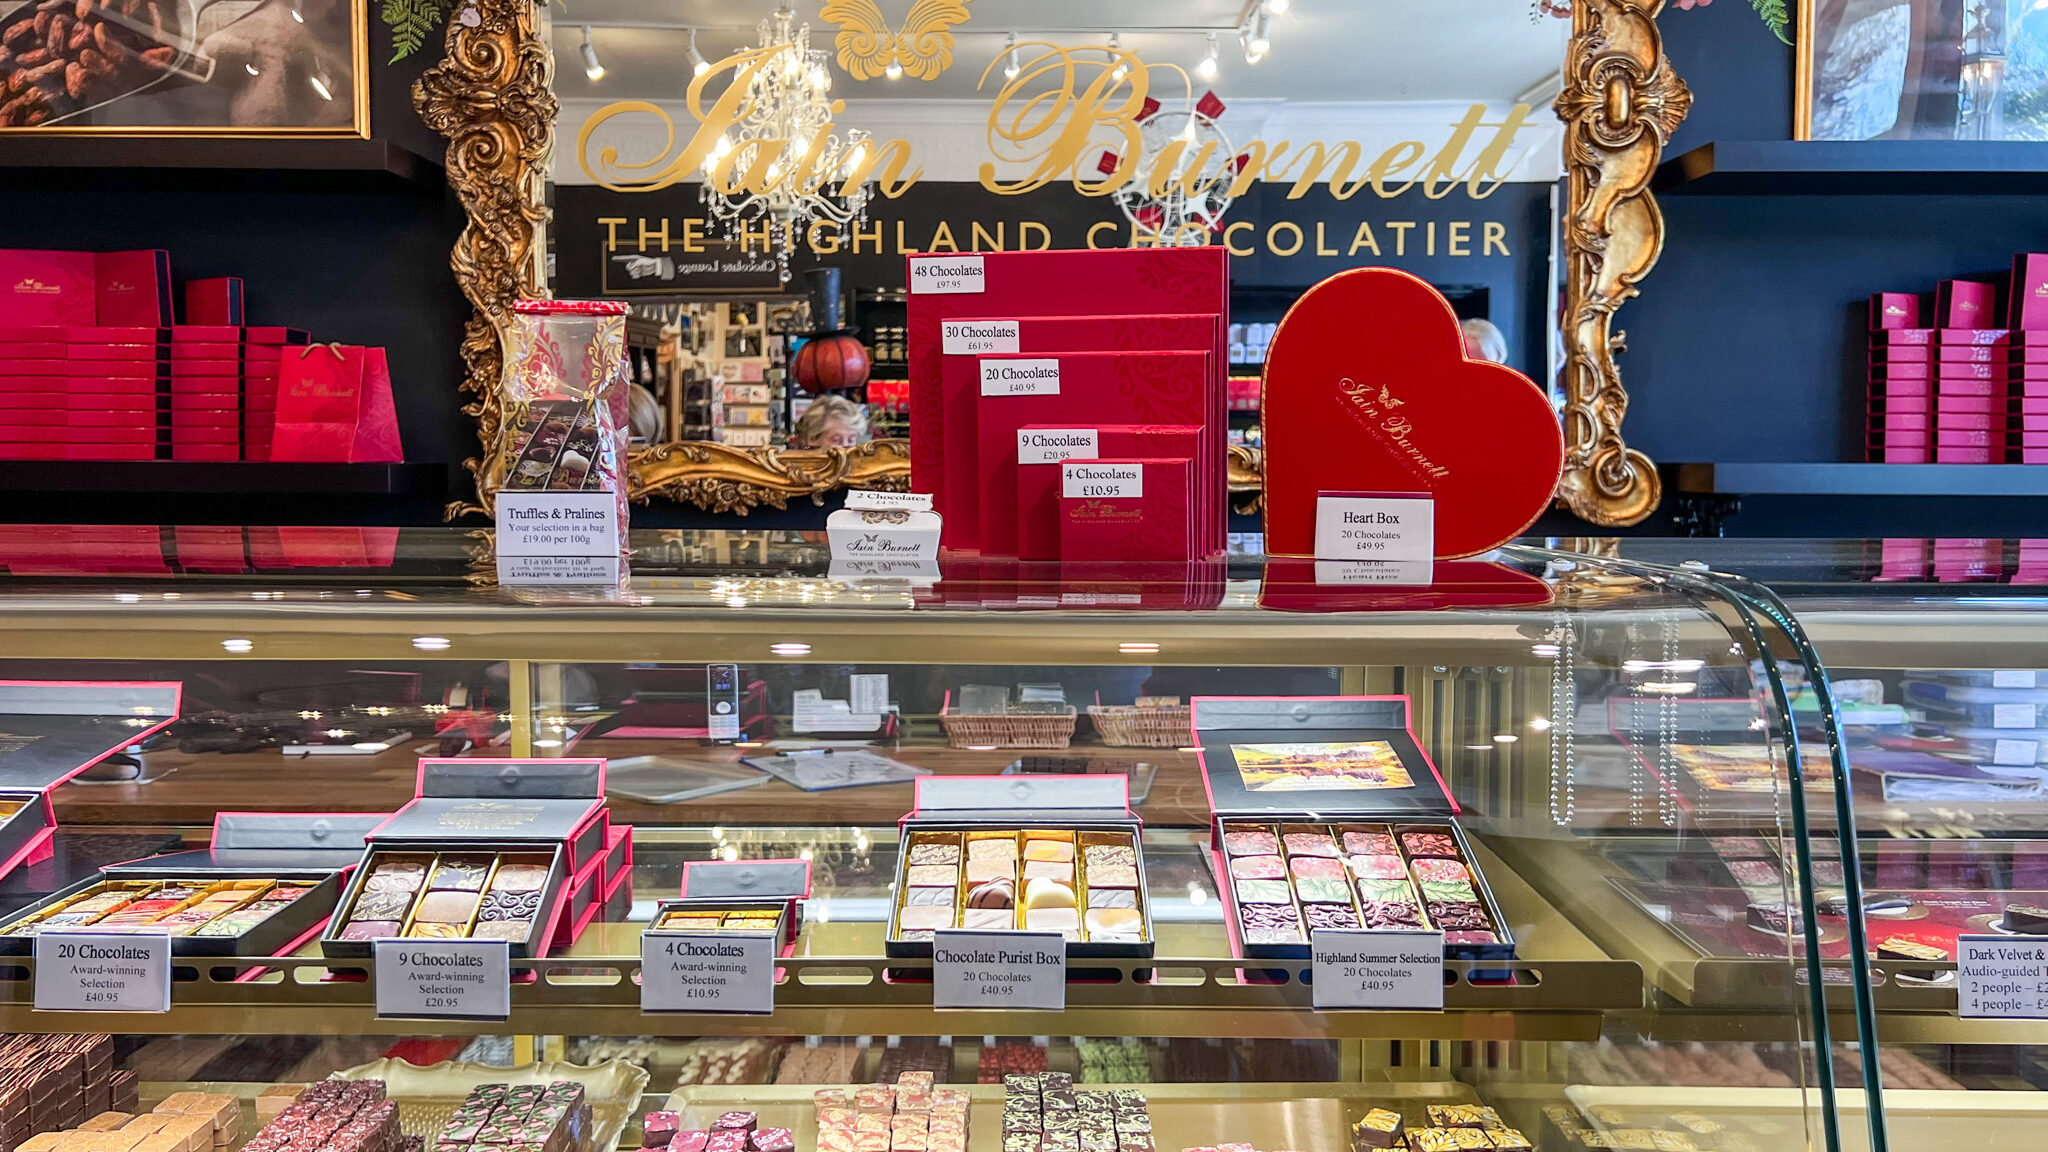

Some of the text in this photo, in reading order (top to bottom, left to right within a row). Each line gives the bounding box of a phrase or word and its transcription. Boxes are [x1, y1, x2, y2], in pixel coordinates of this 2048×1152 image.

[577, 41, 1538, 200] Iain Burnett
[597, 217, 1512, 257] THE HIGHLAND CHOCOLATIER
[914, 264, 983, 277] 48 Chocolates
[936, 280, 961, 289] £97.95
[945, 325, 1016, 338] 30 Chocolates
[968, 341, 993, 350] £61.95
[985, 366, 1059, 380] 20 Chocolates
[1009, 383, 1036, 392] £40.95
[1338, 377, 1450, 479] Iain Burnett
[1022, 434, 1091, 447] 9 Chocolates
[1043, 450, 1070, 460] £20.95
[1065, 467, 1137, 480] 4 Chocolates
[1083, 485, 1120, 496] £10.95
[867, 492, 926, 502] Chocolates
[507, 507, 605, 519] Truffles & Pralines
[1343, 511, 1400, 524] Heart Box
[508, 523, 530, 532] Your
[532, 522, 570, 532] selection
[572, 523, 580, 532] in
[589, 523, 605, 534] bag
[522, 534, 591, 545] £19.00 per 100g
[1341, 530, 1401, 540] 20 Chocolates
[846, 538, 921, 552] Iain Burnett
[1356, 541, 1385, 551] £49.95
[58, 944, 150, 960] 20 Chocolates
[665, 942, 744, 957] 4 Chocolates
[1969, 948, 2045, 961] Dark Velvet &
[399, 952, 483, 967] 9 Chocolates
[935, 949, 1061, 965] Chocolate Purist Box
[1315, 952, 1440, 965] Highland Summer Selection
[70, 964, 146, 977] Award-winning
[671, 961, 747, 975] Award-winning
[1343, 967, 1412, 977] 20 Chocolates
[1961, 966, 2040, 979] Audio-guided
[408, 971, 485, 983] Award-winning
[681, 975, 726, 985] Selection
[963, 971, 1031, 982] 20 Chocolates
[80, 978, 125, 989] Selection
[1360, 980, 1394, 990] £40.95
[1971, 981, 1978, 993] 2
[1982, 981, 2021, 995] people
[419, 985, 464, 995] Selection
[687, 988, 720, 998] £10.95
[980, 986, 1013, 995] £40.95
[85, 992, 118, 1002] £40.95
[425, 998, 458, 1008] £20.95
[1971, 998, 1979, 1009] 4
[1982, 998, 2021, 1012] people
